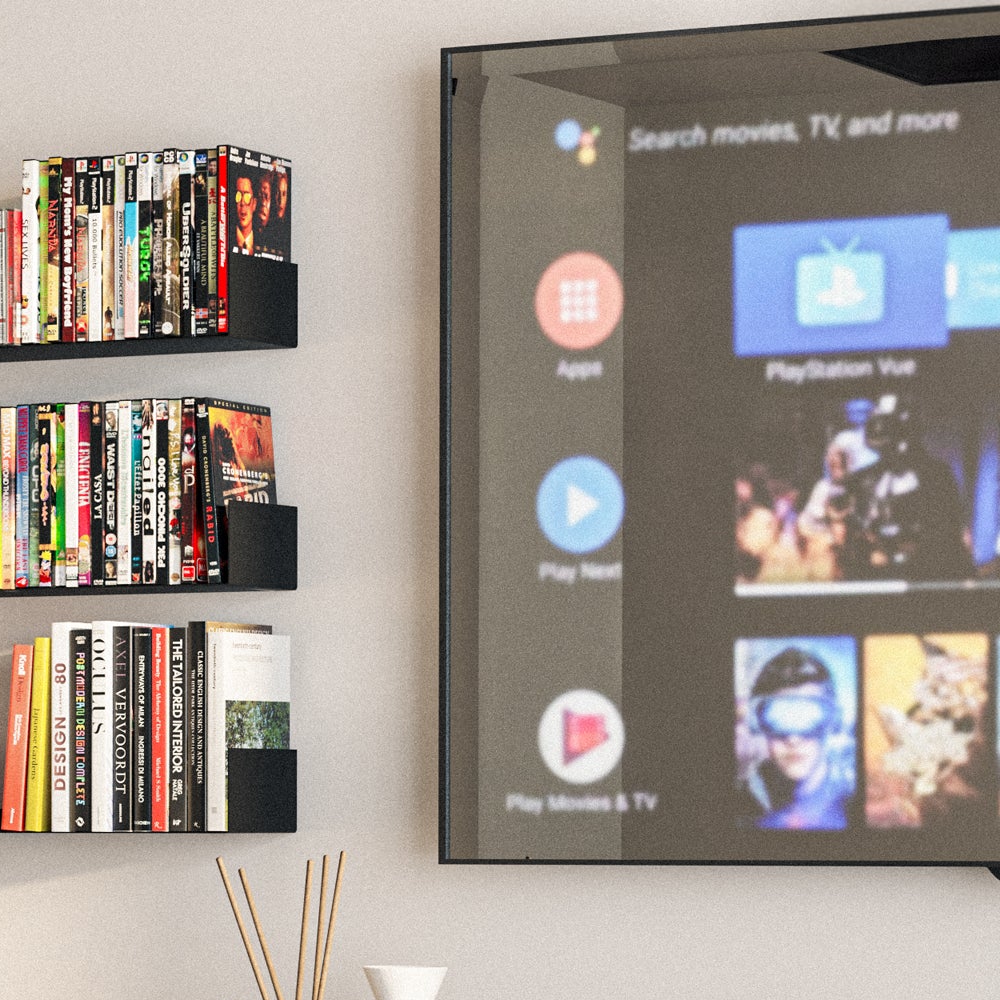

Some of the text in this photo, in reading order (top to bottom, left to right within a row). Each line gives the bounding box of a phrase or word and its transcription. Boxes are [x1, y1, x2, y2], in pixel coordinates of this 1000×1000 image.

[628, 124, 706, 152] Search
[712, 120, 799, 145] movies,
[848, 110, 891, 136] and
[898, 111, 958, 132] more
[63, 177, 72, 327] My Mom's New Boyfriend
[557, 358, 603, 380] Apps
[766, 356, 916, 383] PlayStation Vue
[214, 400, 239, 408] SPECIAL
[107, 443, 115, 531] WAIST DEEP
[143, 436, 154, 536] nailed
[94, 506, 102, 519] LA
[206, 506, 214, 543] RABID
[539, 562, 577, 583] Play
[18, 655, 27, 676] Knoll
[116, 636, 126, 682] AXEL
[92, 638, 106, 735] OCULUS
[138, 695, 145, 704] OF
[172, 639, 183, 773] THE TAILORED INTERIOR
[31, 708, 40, 780] Japanese Gardens
[55, 663, 66, 791] DESIGN 80
[75, 652, 85, 806] POSTMODERN DESIGN COMPLETE
[116, 688, 126, 795] VERVOORDT
[506, 793, 658, 814] Play Movies & TV
